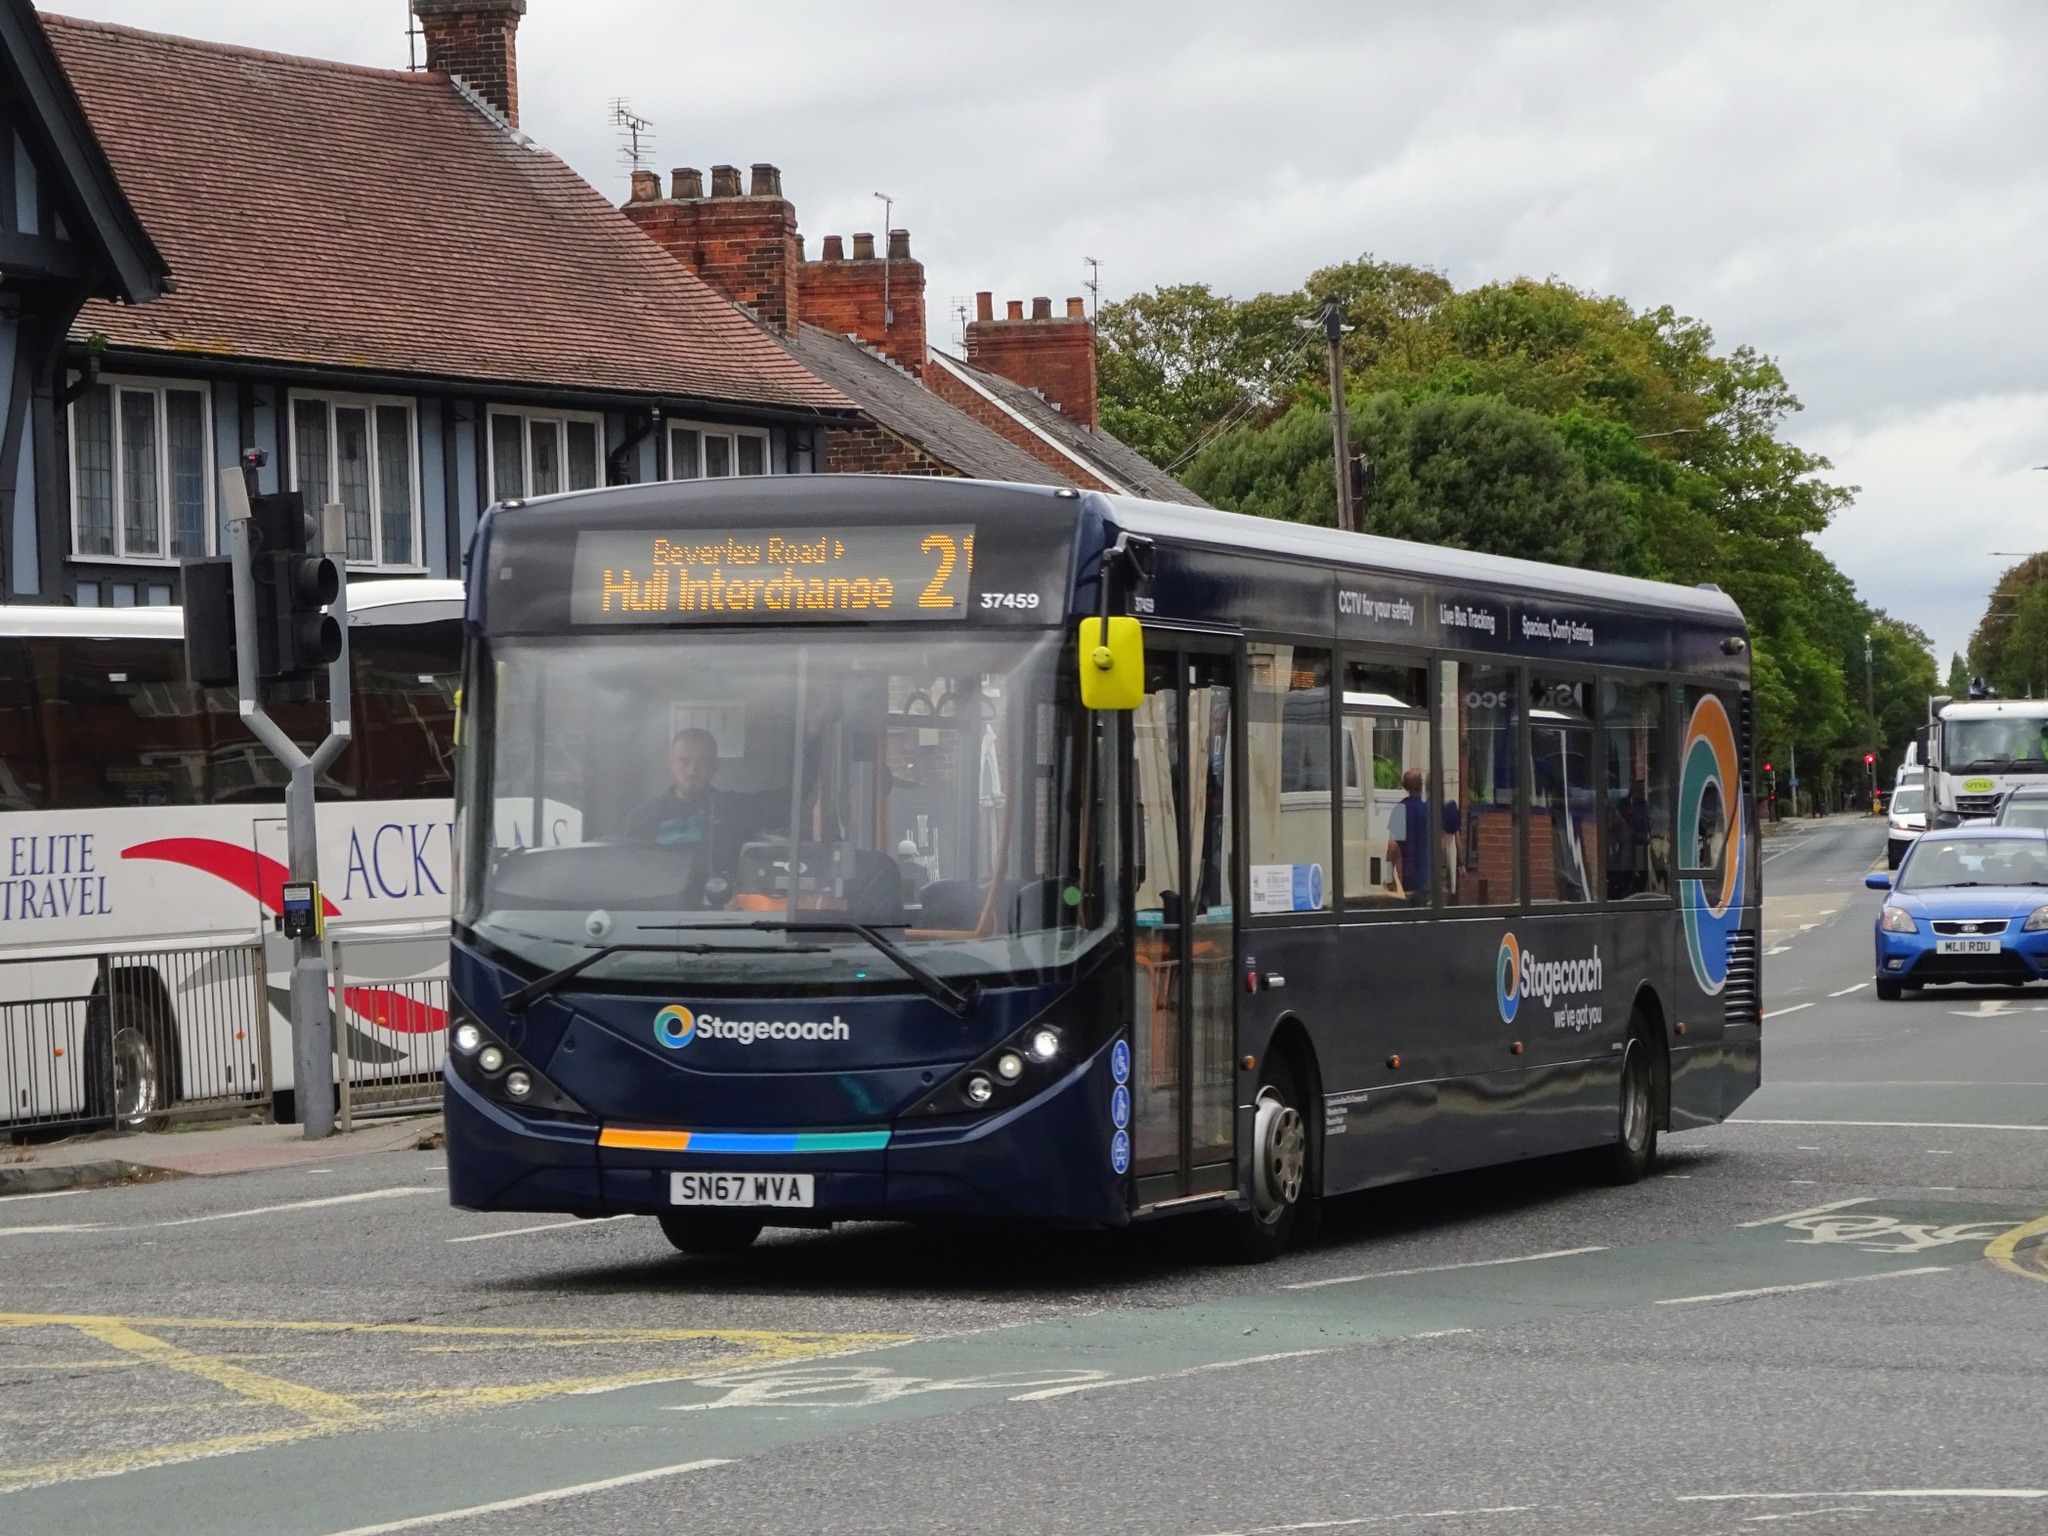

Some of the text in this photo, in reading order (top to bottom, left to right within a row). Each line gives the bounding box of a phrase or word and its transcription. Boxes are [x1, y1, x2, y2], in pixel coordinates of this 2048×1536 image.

[653, 536, 828, 567] Beverley Road
[602, 566, 894, 612] Hull Interchange
[980, 592, 1041, 610] 37459
[1338, 590, 1415, 627] CCTV for your safety
[1440, 603, 1496, 636] Live Bus Tracking
[1522, 614, 1594, 647] Spacious, Comfy Seating
[1964, 782, 1994, 790] SPINKS
[10, 834, 96, 877] ELITE
[0, 876, 113, 921] TRAVEL
[1968, 941, 1991, 952] RDU
[1520, 944, 1602, 1008] Stagecoach
[696, 1014, 849, 1045] Stagecoach
[1553, 1003, 1602, 1032] we've got you
[682, 1175, 802, 1201] SN67 WVA
